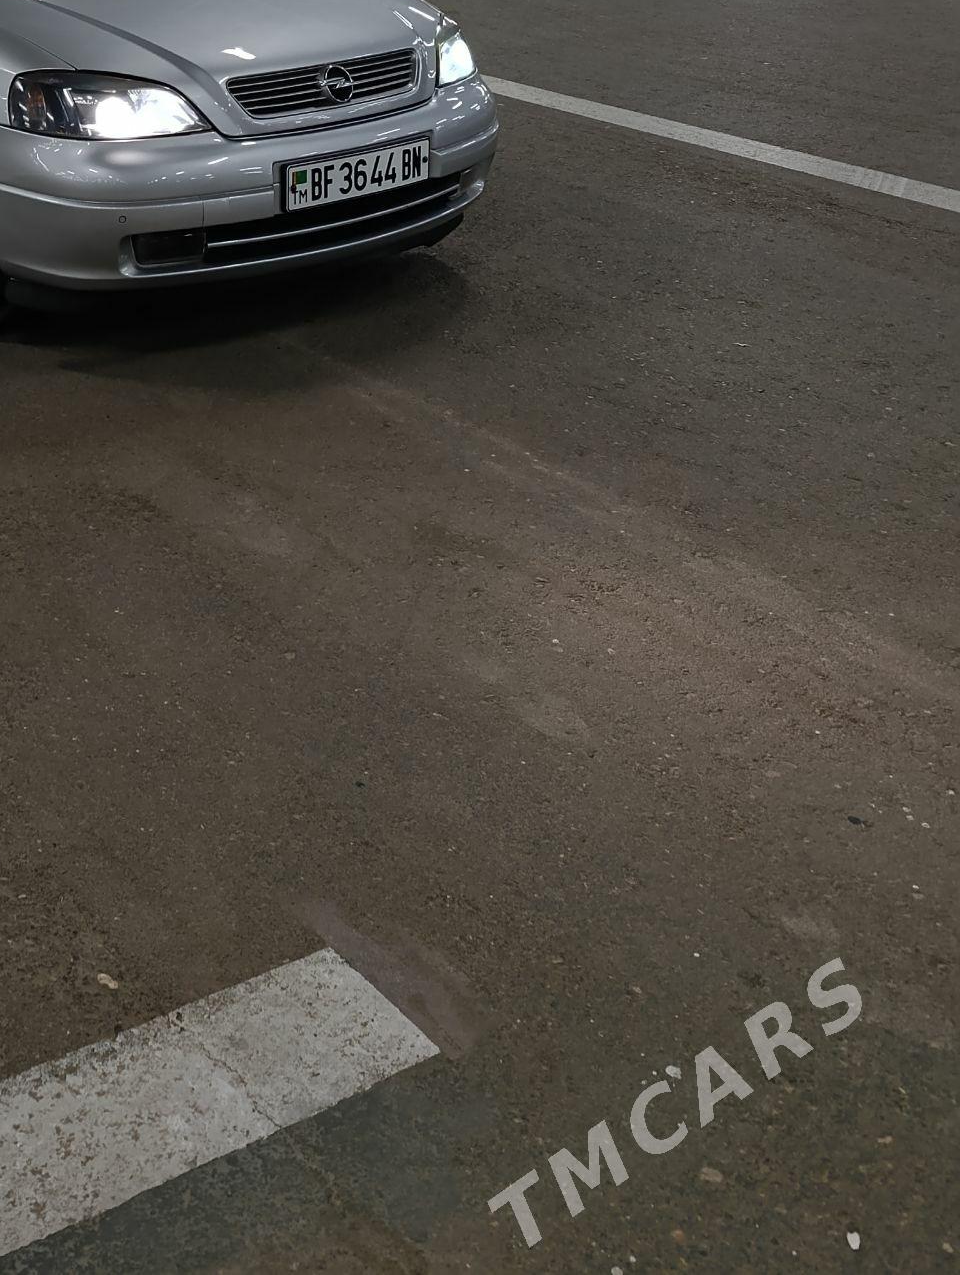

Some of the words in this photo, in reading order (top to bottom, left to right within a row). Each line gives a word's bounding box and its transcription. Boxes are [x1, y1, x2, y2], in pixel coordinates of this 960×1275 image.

[291, 188, 308, 205] TM
[311, 164, 335, 202] BF
[339, 152, 397, 195] 3644
[401, 145, 422, 181] BN
